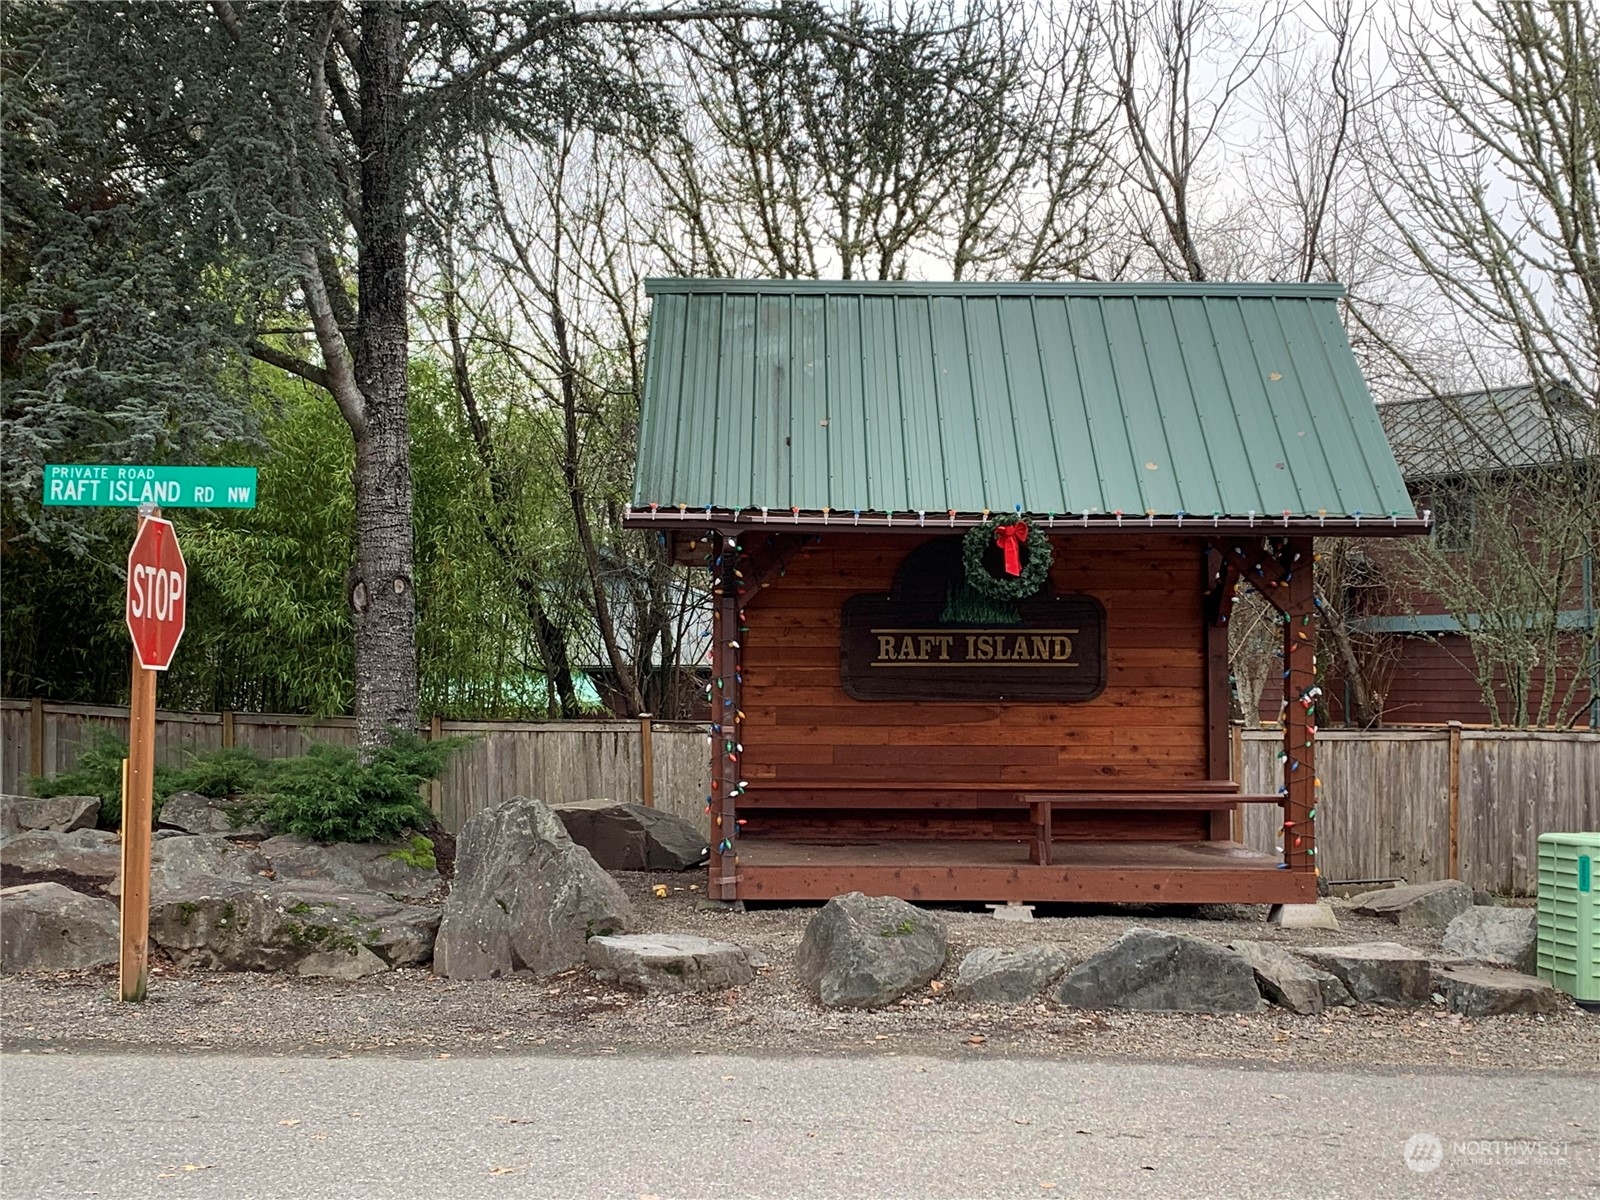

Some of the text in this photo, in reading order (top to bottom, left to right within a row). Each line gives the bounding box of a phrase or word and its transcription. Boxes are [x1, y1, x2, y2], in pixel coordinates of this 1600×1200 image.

[51, 467, 155, 480] PRIVATE ROAD
[50, 480, 251, 503] RAFT ISLAND RD NW
[131, 563, 182, 622] STOP
[877, 635, 1073, 660] RAFT ISLAND
